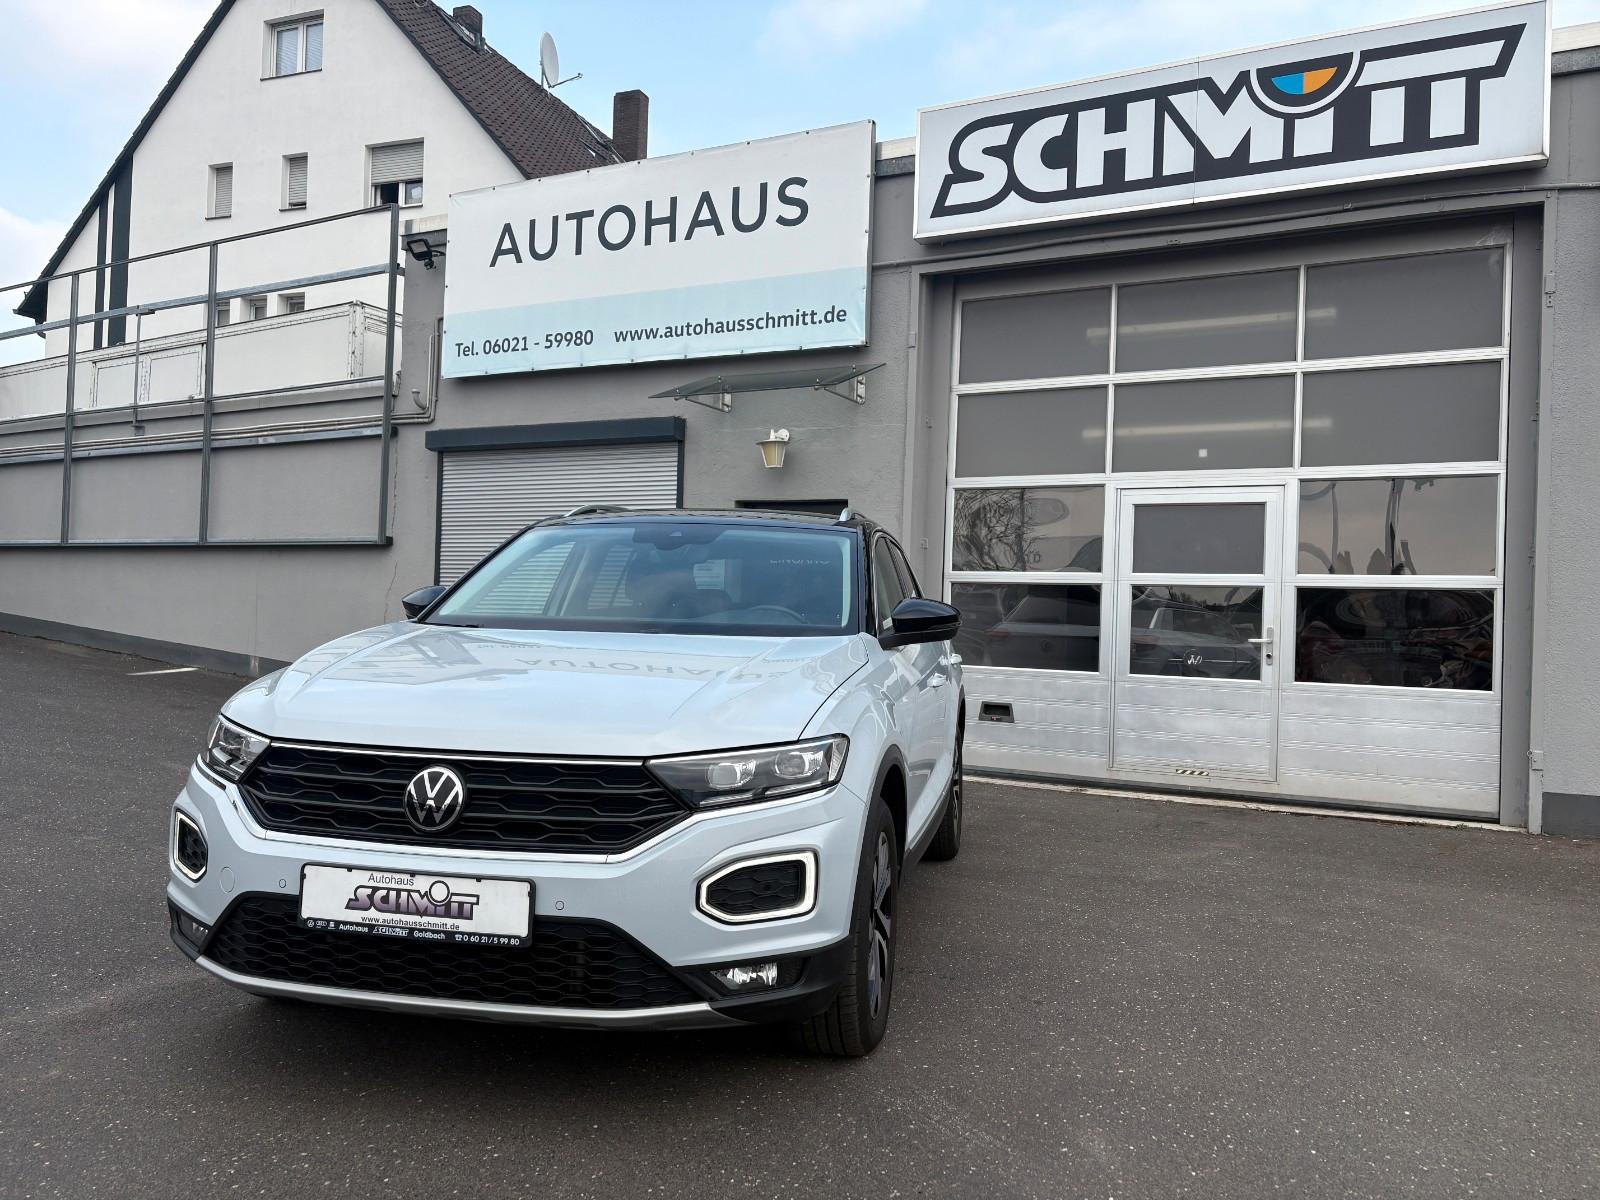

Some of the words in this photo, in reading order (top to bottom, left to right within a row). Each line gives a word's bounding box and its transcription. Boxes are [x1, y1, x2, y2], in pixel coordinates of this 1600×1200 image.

[930, 22, 1527, 218] SCHMITT
[489, 176, 809, 268] AUTOHAUS
[455, 342, 479, 358] Tel.
[482, 336, 529, 355] 06021
[544, 329, 594, 350] 59980
[613, 304, 847, 343] www.autohausschmitt.de
[367, 873, 415, 886] Autohaus
[344, 880, 480, 920] SCHMITT
[338, 923, 369, 933] Autohaus
[413, 930, 446, 940] Goldbach
[470, 935, 480, 943] 60
[499, 937, 509, 945] 99
[510, 937, 520, 946] 80
[360, 915, 460, 931] www.autohausschmitt.de
